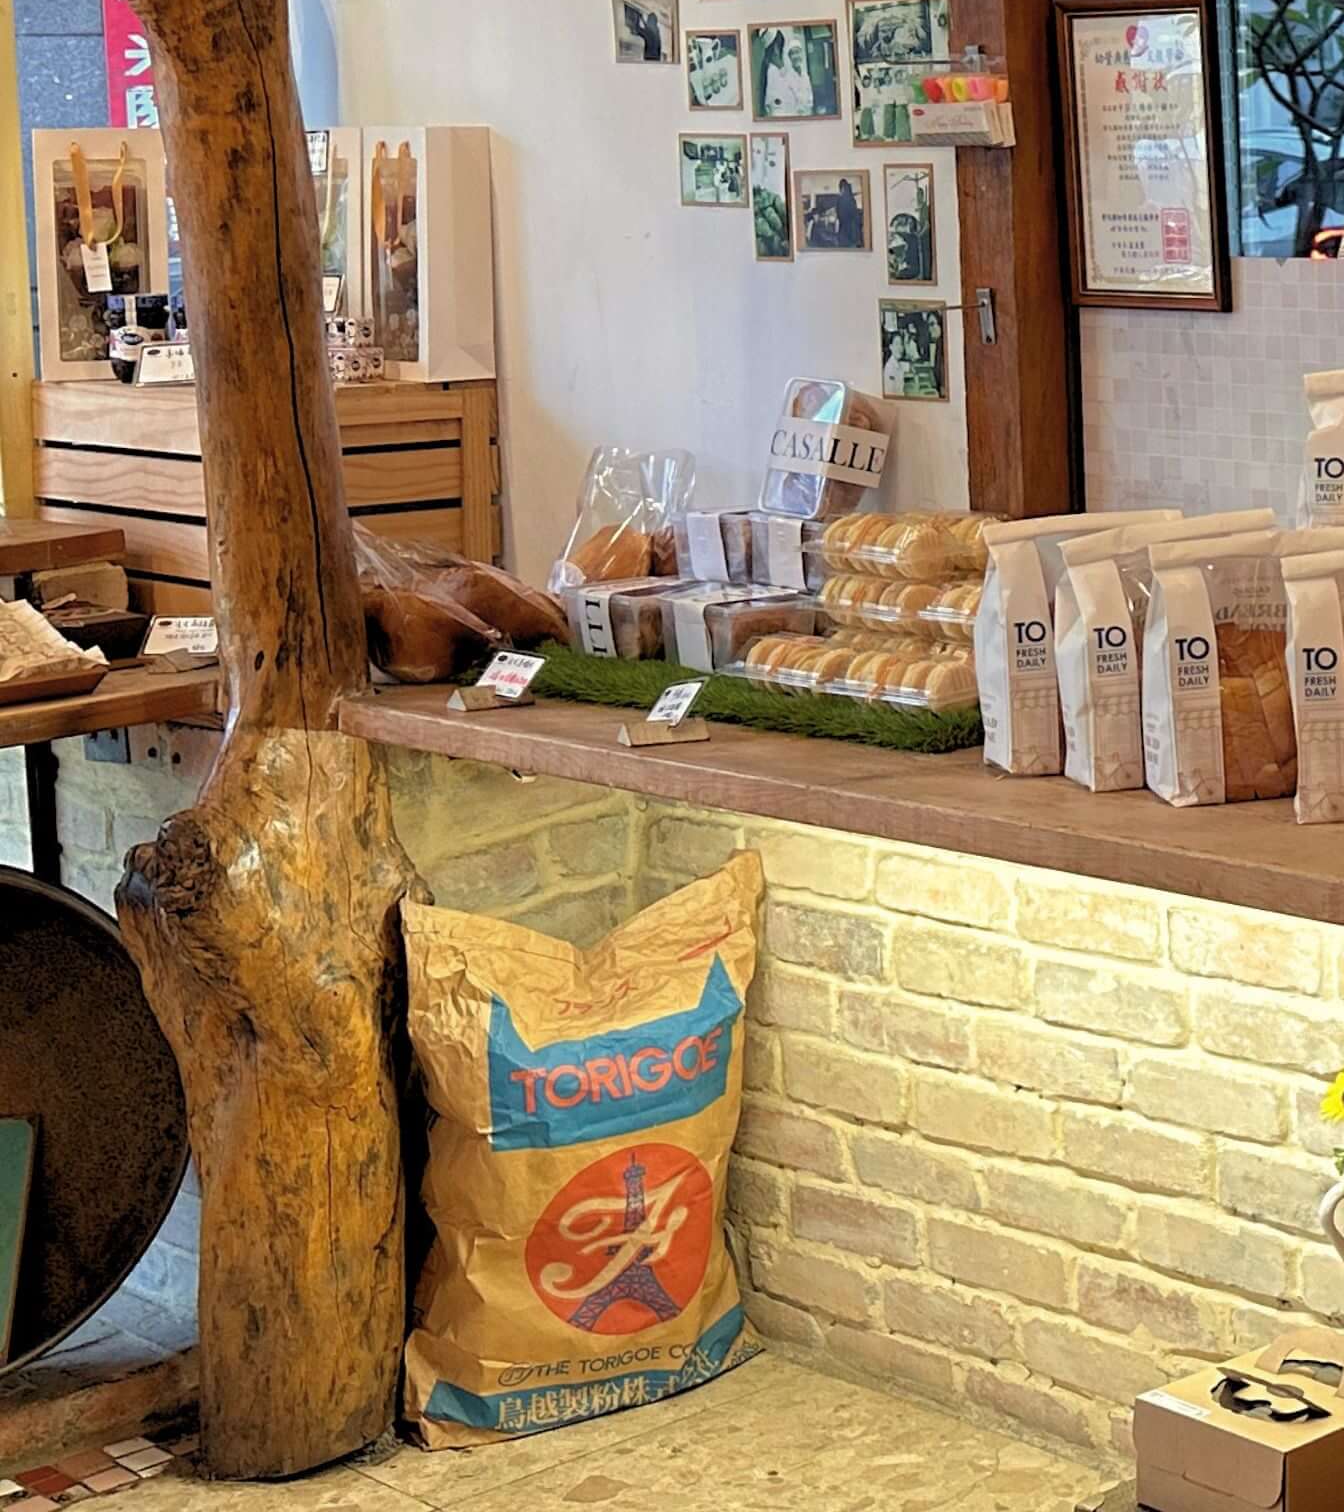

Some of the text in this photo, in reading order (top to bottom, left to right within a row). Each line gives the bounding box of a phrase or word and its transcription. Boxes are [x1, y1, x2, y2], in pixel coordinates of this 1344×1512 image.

[770, 428, 885, 474] CASALLE
[1315, 483, 1344, 493] FRESH
[1315, 493, 1344, 504] DAILY
[1014, 621, 1047, 644] TO
[1093, 626, 1127, 649] TO
[1016, 647, 1047, 659] FRESH
[1175, 637, 1210, 661] TO
[1016, 658, 1047, 669] DAILY
[1096, 652, 1128, 664] FRESH
[1302, 647, 1338, 671] TO
[1096, 663, 1128, 675] DAILY
[1177, 664, 1210, 676] FRESH
[1178, 675, 1210, 688] DAILY
[1304, 676, 1337, 687] FRESH
[1304, 687, 1337, 698] DAILY
[508, 1028, 724, 1116] TORIGOE
[534, 1360, 571, 1377] THE
[579, 1346, 662, 1374] TORIGOE
